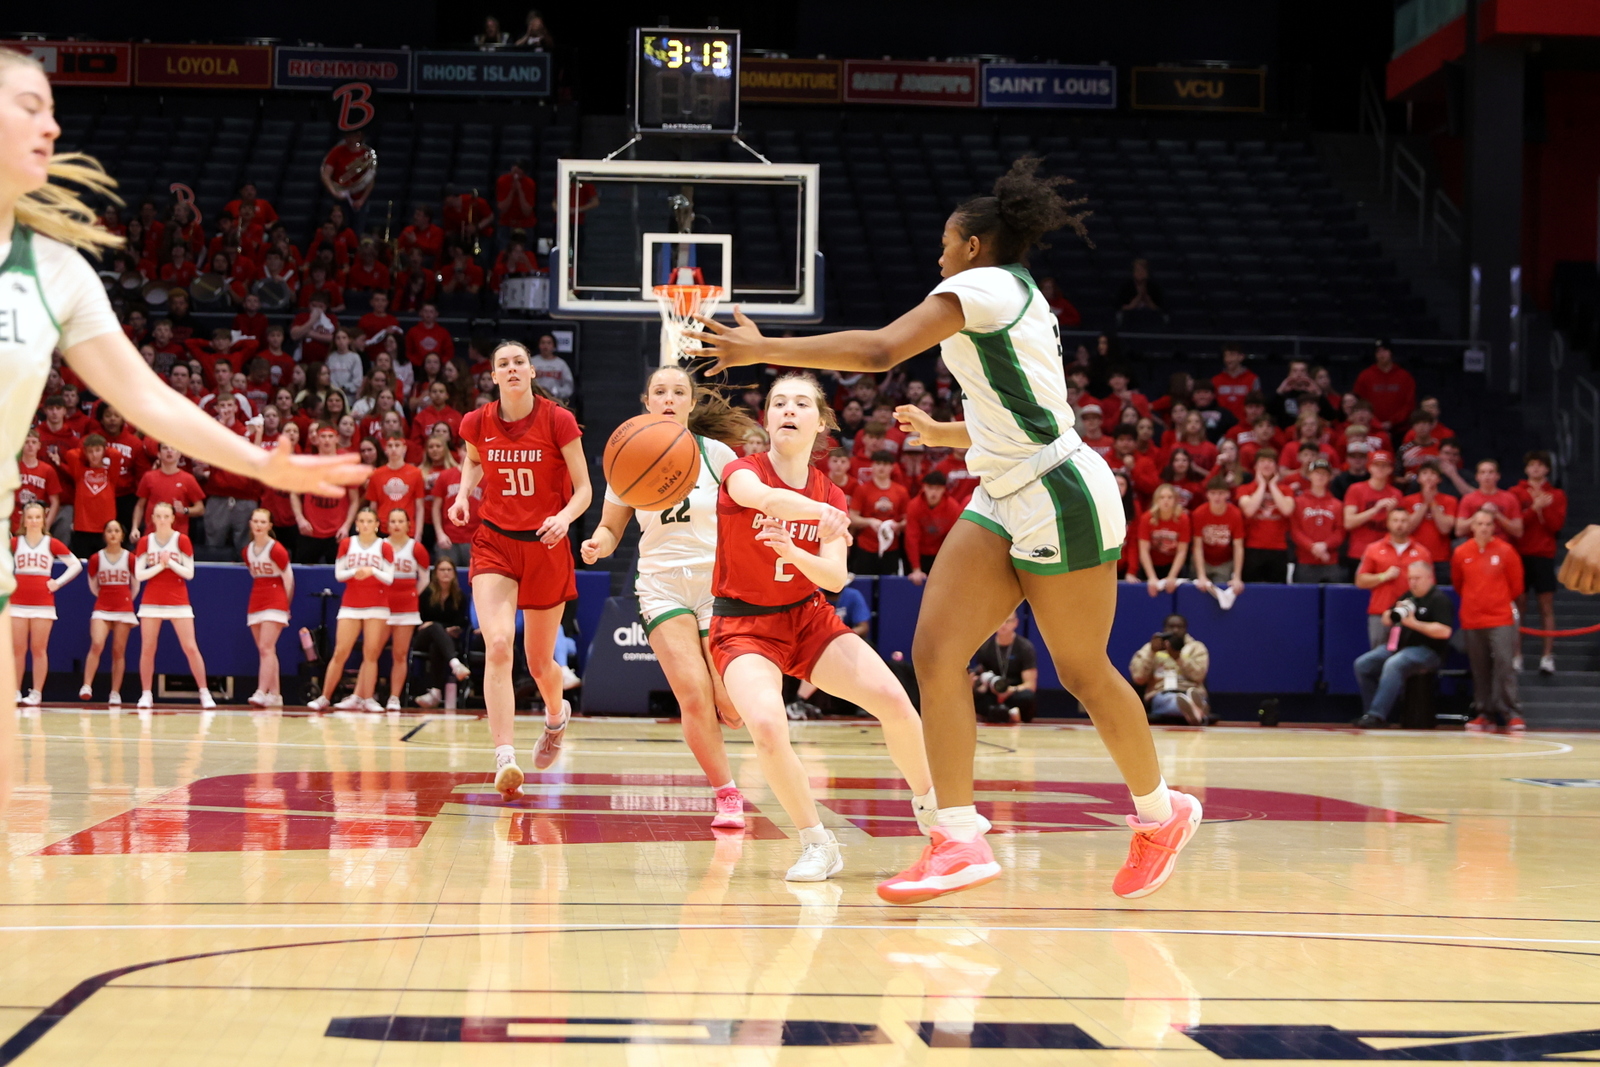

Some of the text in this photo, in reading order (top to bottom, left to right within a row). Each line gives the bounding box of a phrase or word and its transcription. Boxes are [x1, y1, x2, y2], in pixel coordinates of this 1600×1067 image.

[61, 53, 118, 73] 10
[667, 38, 729, 70] 3:13
[166, 56, 240, 76] LOYOLA
[287, 58, 398, 80] RICHMOND
[422, 64, 542, 83] RHODE ISLAND
[740, 71, 837, 90] BONAVENTURE
[987, 76, 1111, 97] SAINT LOUIS
[1173, 78, 1225, 100] VCU
[331, 81, 376, 132] B
[487, 449, 542, 463] BELLEVUE
[498, 467, 535, 497] 30
[16, 553, 49, 570] BHS
[347, 553, 381, 569] BHS
[98, 569, 131, 584] BHS
[613, 621, 650, 647] alt
